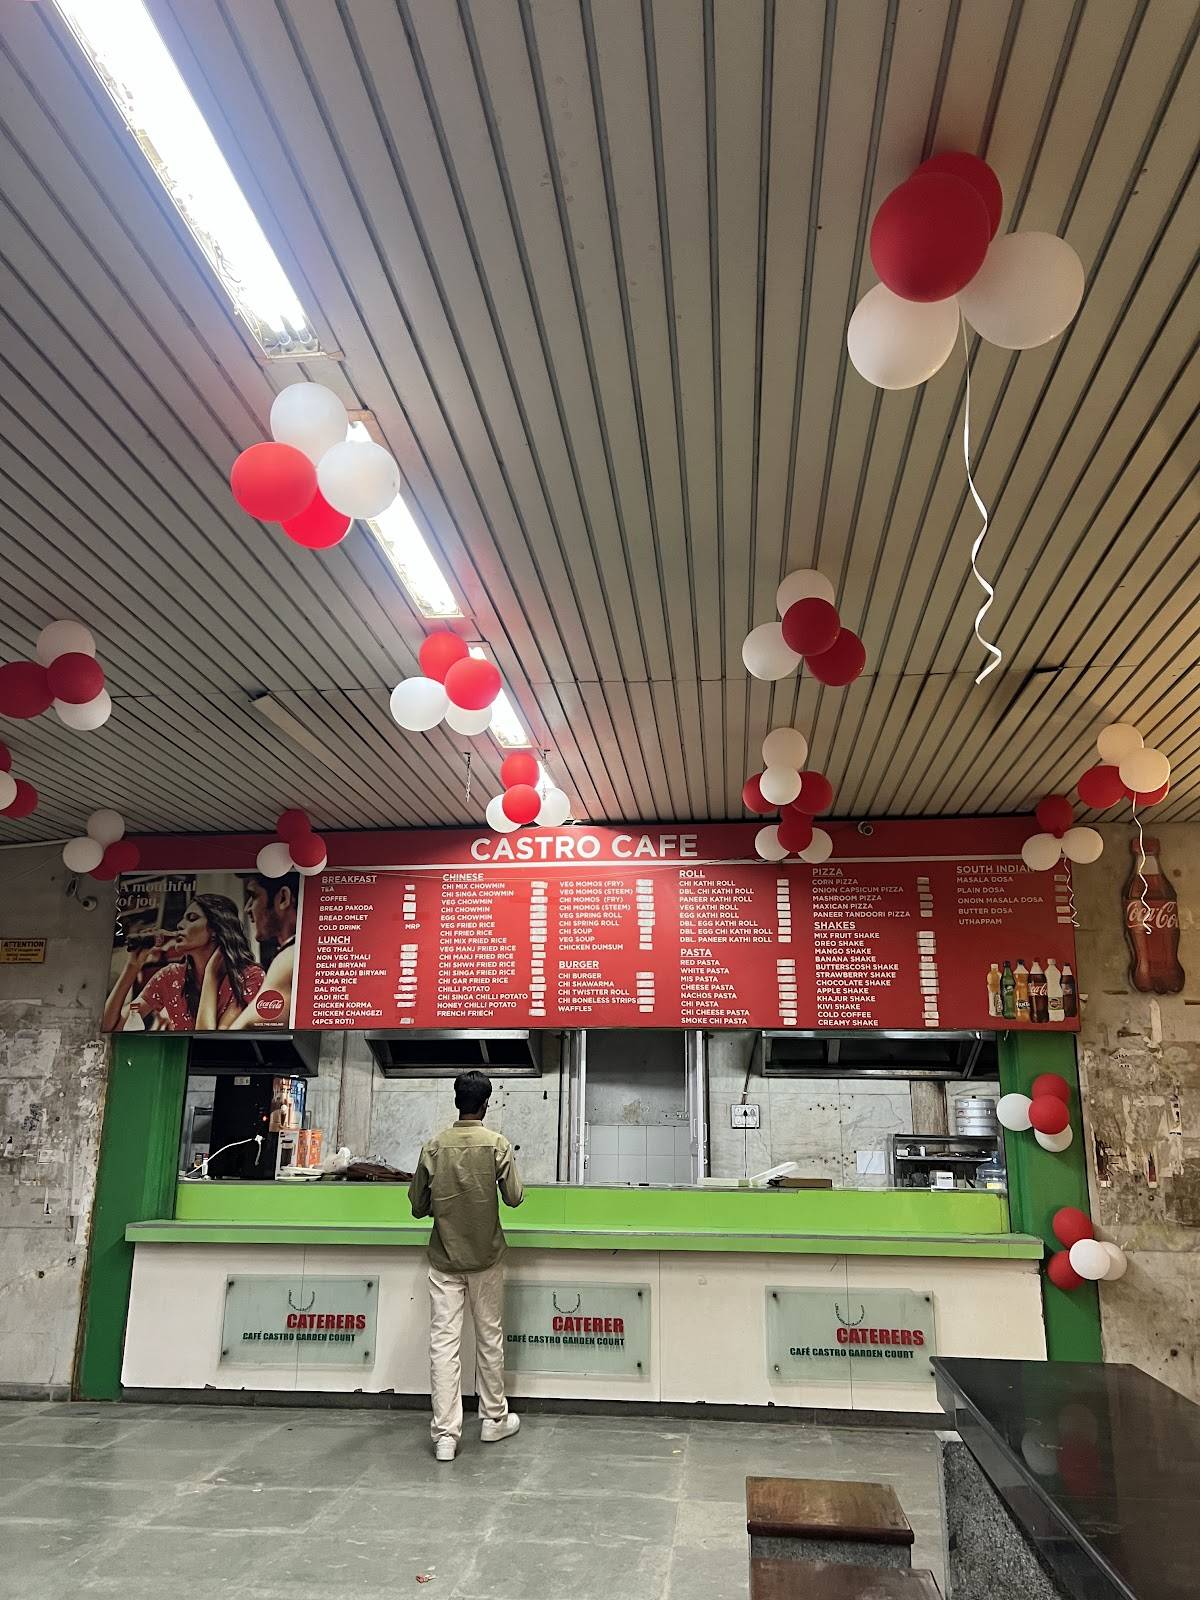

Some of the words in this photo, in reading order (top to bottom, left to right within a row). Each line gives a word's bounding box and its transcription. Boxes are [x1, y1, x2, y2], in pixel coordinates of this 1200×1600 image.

[470, 835, 600, 861] CASTRO
[612, 834, 697, 857] CAFE
[812, 868, 843, 876] PIZZA
[956, 865, 993, 873] SOUTH
[322, 875, 377, 883] BREAKFAST
[442, 873, 484, 881] CHINESE
[120, 883, 129, 892] A
[132, 880, 196, 893] mouthful
[119, 895, 134, 906] of
[814, 921, 856, 929] SHAKES
[318, 936, 351, 944] LUNCH
[680, 948, 712, 956] PASTA
[257, 1000, 283, 1009] Coca-Cola
[287, 1314, 366, 1329] CATERERS
[552, 1316, 624, 1333] CATERER
[243, 1331, 262, 1340] CAFÉ
[264, 1333, 294, 1341] CASTRO
[296, 1333, 327, 1341] GARDEN
[329, 1334, 355, 1342] COURT
[507, 1334, 526, 1343] CAFÉ
[528, 1336, 560, 1344] CASTRO
[563, 1337, 595, 1345] GARDEN
[597, 1338, 624, 1346] COURT
[836, 1328, 924, 1346] CATERERS
[790, 1347, 810, 1356] CAFÉ
[812, 1348, 846, 1357] CASTRO
[849, 1349, 883, 1358] GARDEN
[885, 1350, 914, 1359] COURT
